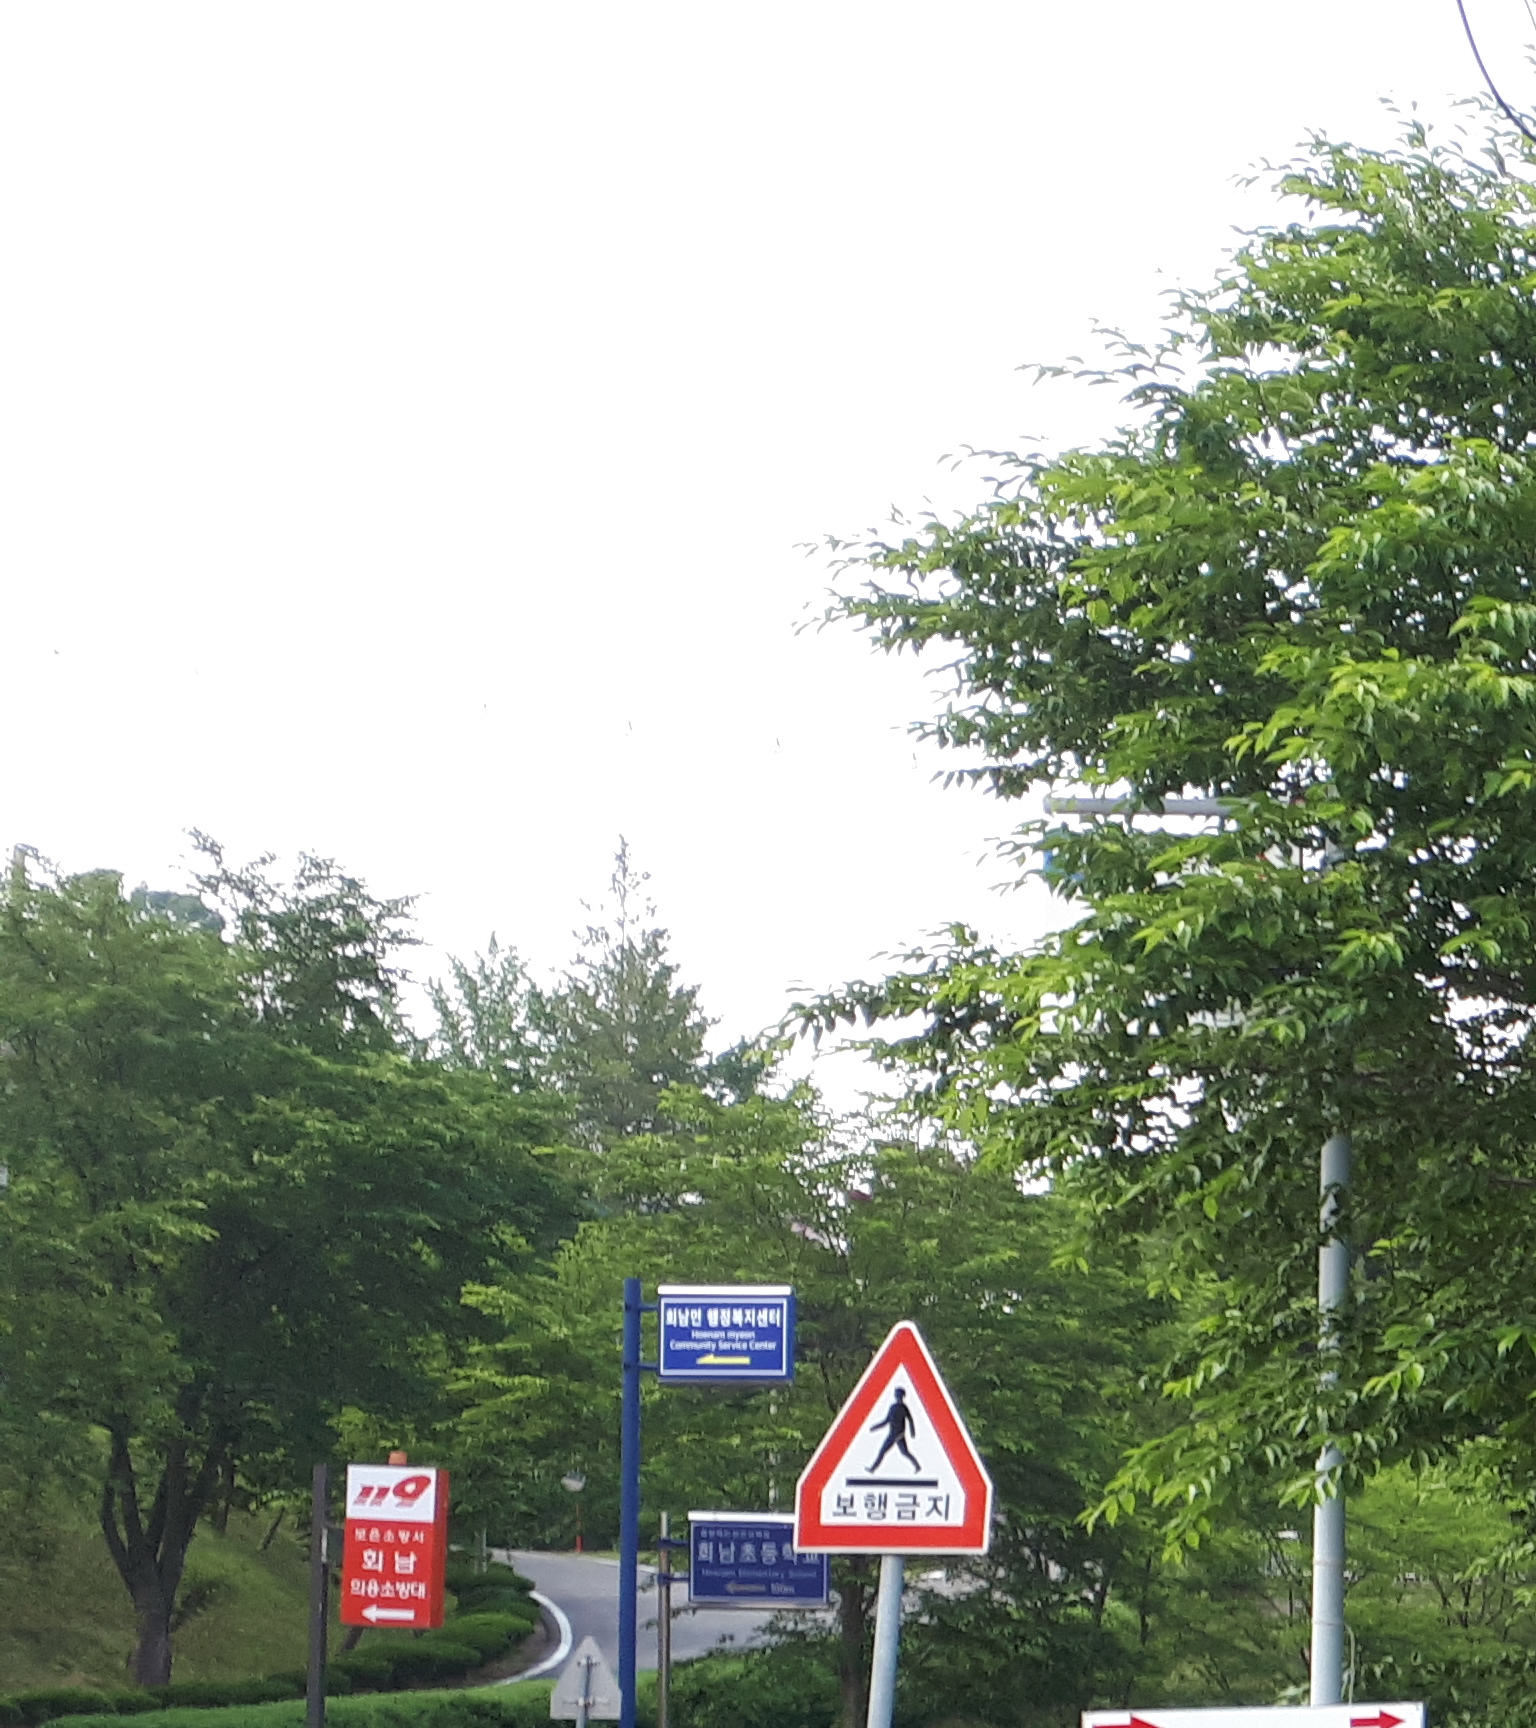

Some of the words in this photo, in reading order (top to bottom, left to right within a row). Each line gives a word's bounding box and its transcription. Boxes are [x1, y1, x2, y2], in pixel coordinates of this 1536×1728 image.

[352, 1475, 432, 1508] 119
[832, 1492, 951, 1521] 보행금지
[361, 1549, 417, 1575] 회남
[350, 1578, 427, 1600] 의용소방대
